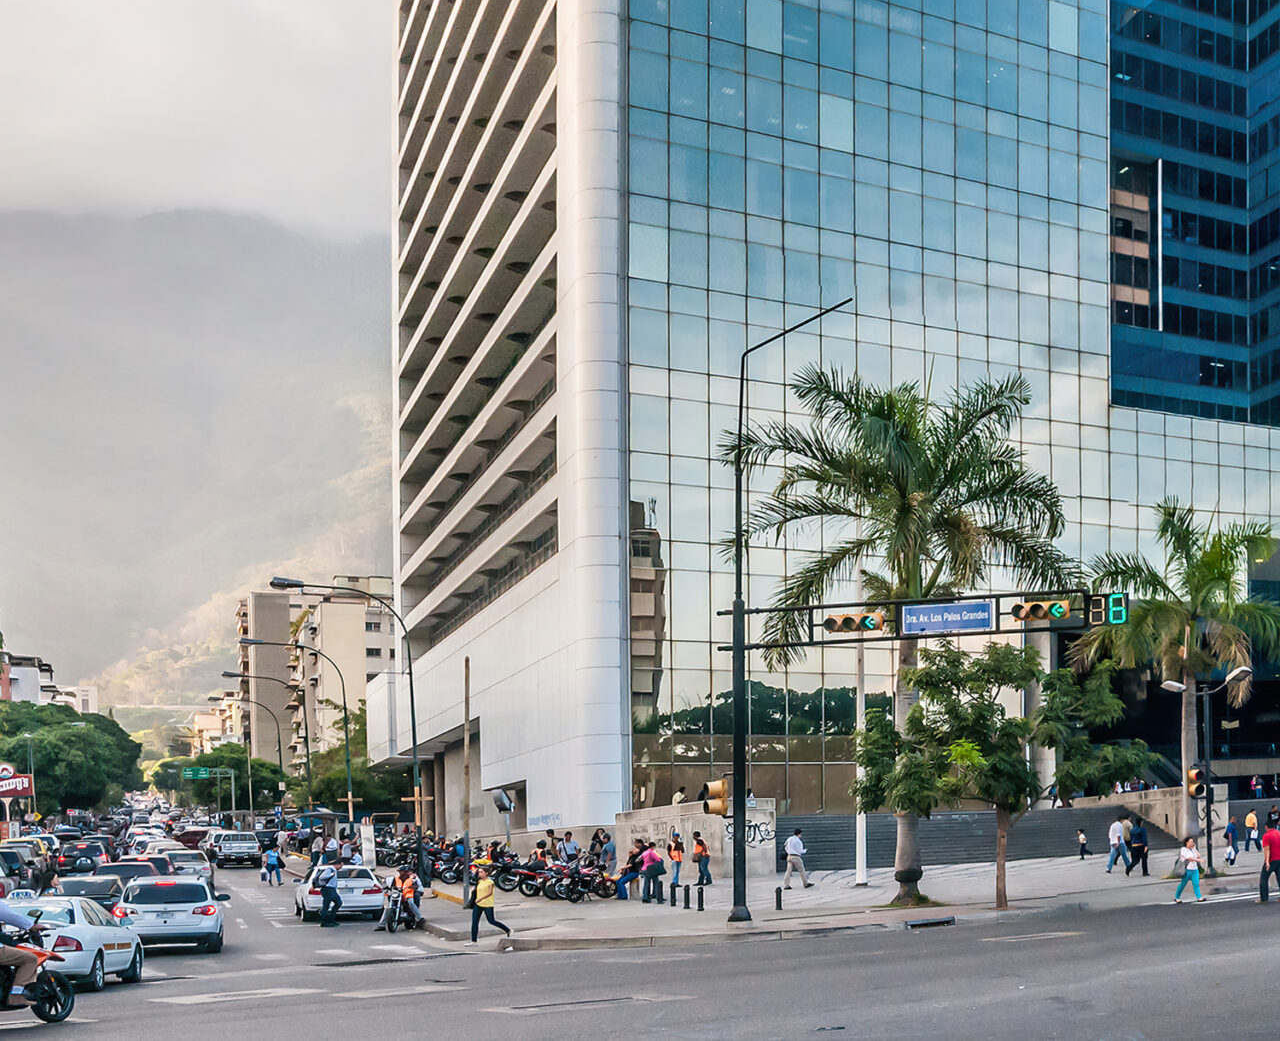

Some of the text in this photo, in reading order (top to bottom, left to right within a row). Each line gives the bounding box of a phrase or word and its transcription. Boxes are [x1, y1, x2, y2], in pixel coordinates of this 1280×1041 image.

[930, 613, 942, 622] Los
[943, 612, 961, 621] Palos
[961, 610, 989, 621] Grandes
